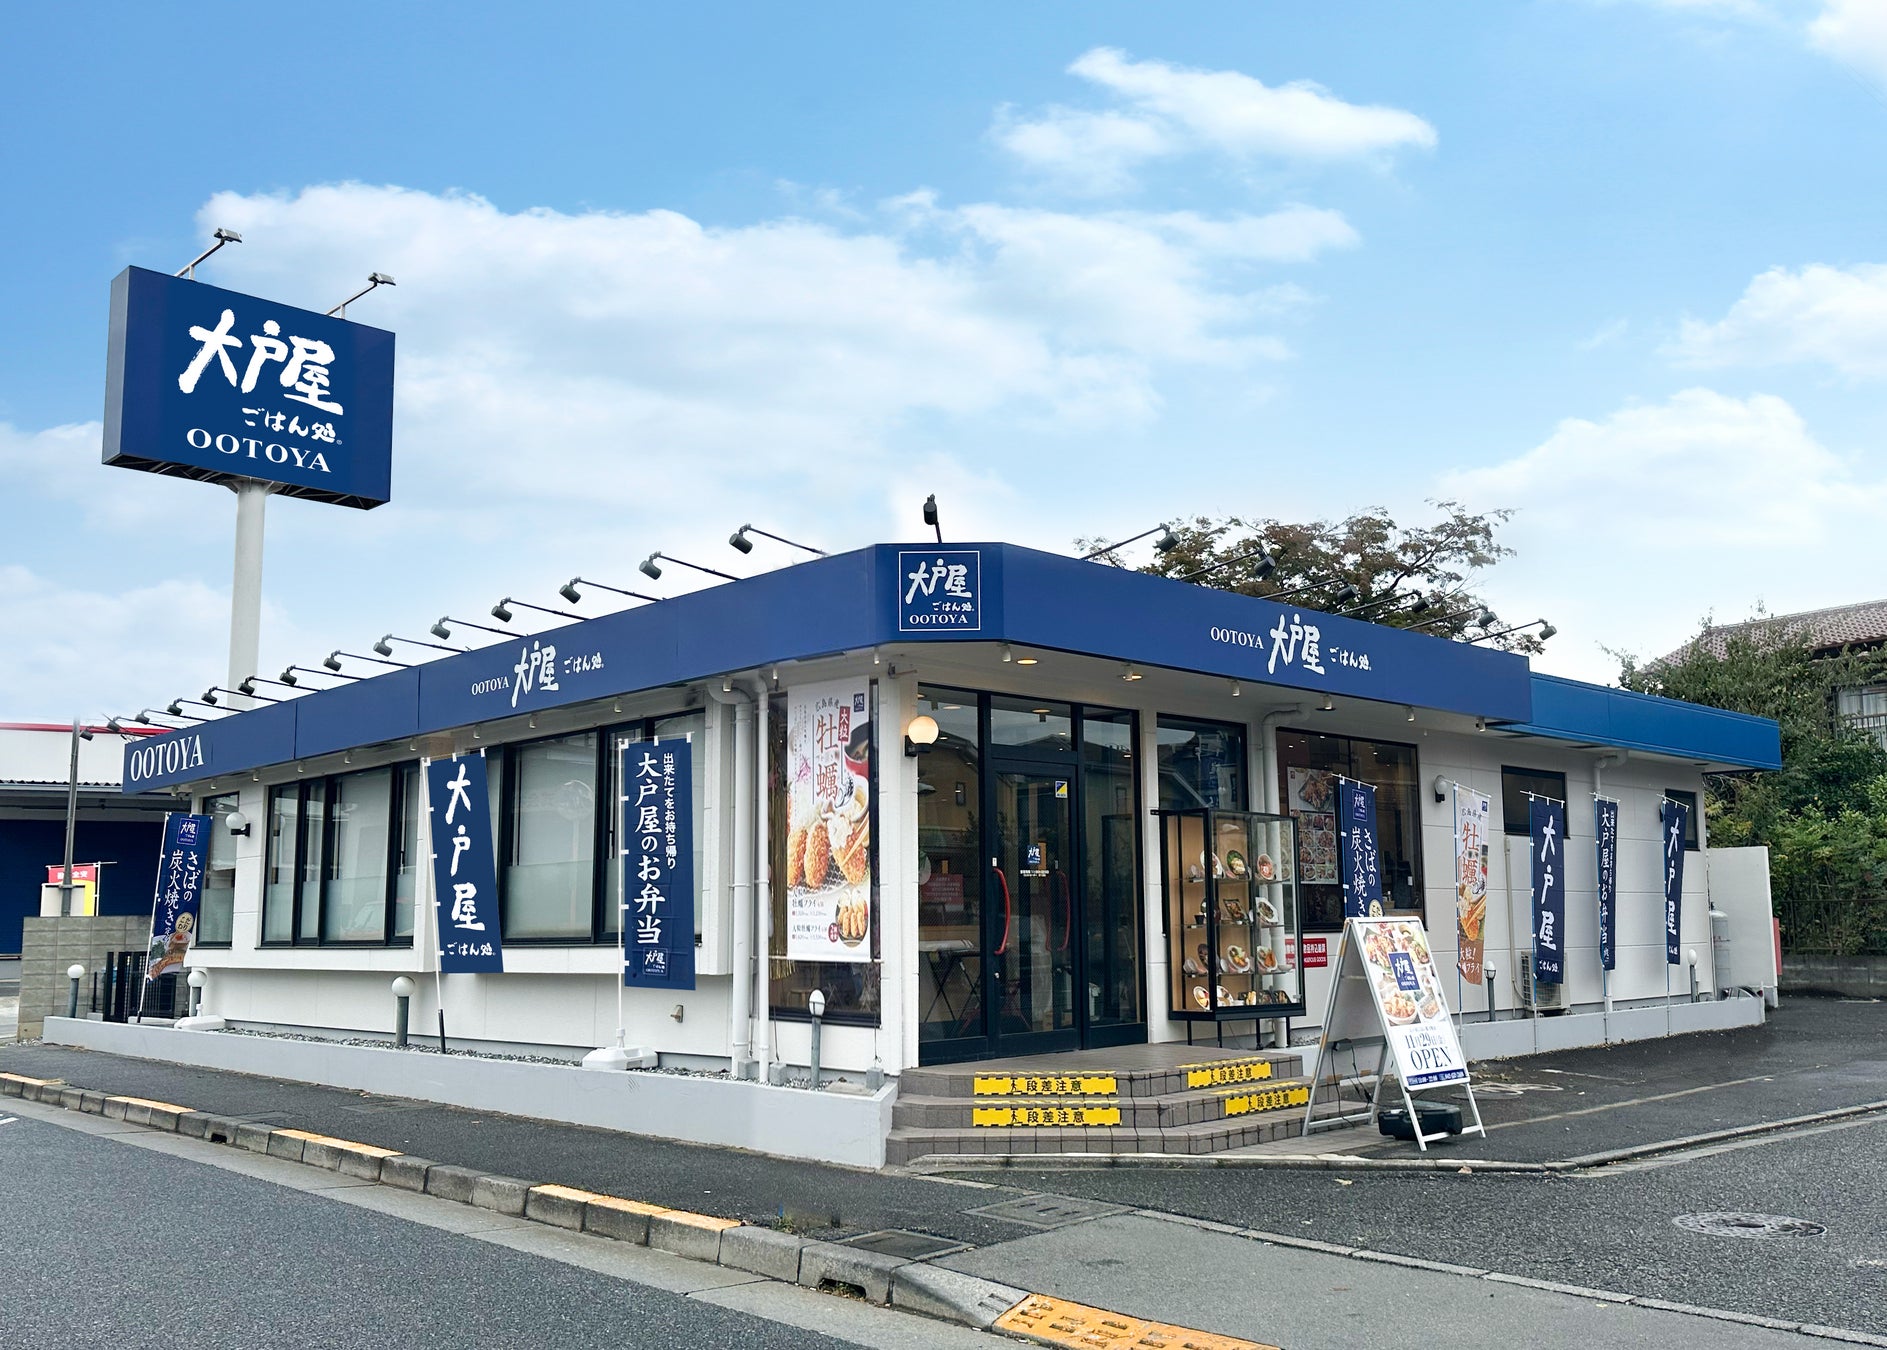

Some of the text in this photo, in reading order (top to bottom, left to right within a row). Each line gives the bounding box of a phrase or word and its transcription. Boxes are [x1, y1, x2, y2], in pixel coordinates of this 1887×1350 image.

[178, 308, 343, 415] 大戸屋
[242, 407, 336, 444] ごはん処
[187, 428, 331, 473] OOTOYA
[905, 558, 972, 605] 大戸屋
[909, 614, 968, 625] OOTOYA
[1210, 626, 1264, 650] OOTOYA
[1267, 613, 1325, 675] 大戸屋
[471, 676, 509, 695] OOTOYA
[511, 640, 559, 708] 大戸屋
[130, 734, 204, 782] OOTOYA
[663, 753, 677, 869] 出来たてをお持ち帰り
[445, 763, 485, 931] 大戸屋
[634, 752, 665, 944] 大戸屋のお弁当
[1364, 828, 1377, 887] さばの
[182, 851, 201, 902] さばの
[1540, 815, 1557, 950] 大戸屋
[1219, 1067, 1252, 1081] 段差注意
[1410, 1046, 1453, 1070] OPEN
[1026, 1080, 1082, 1092] 段差注意
[1027, 1110, 1085, 1123] 段差注意
